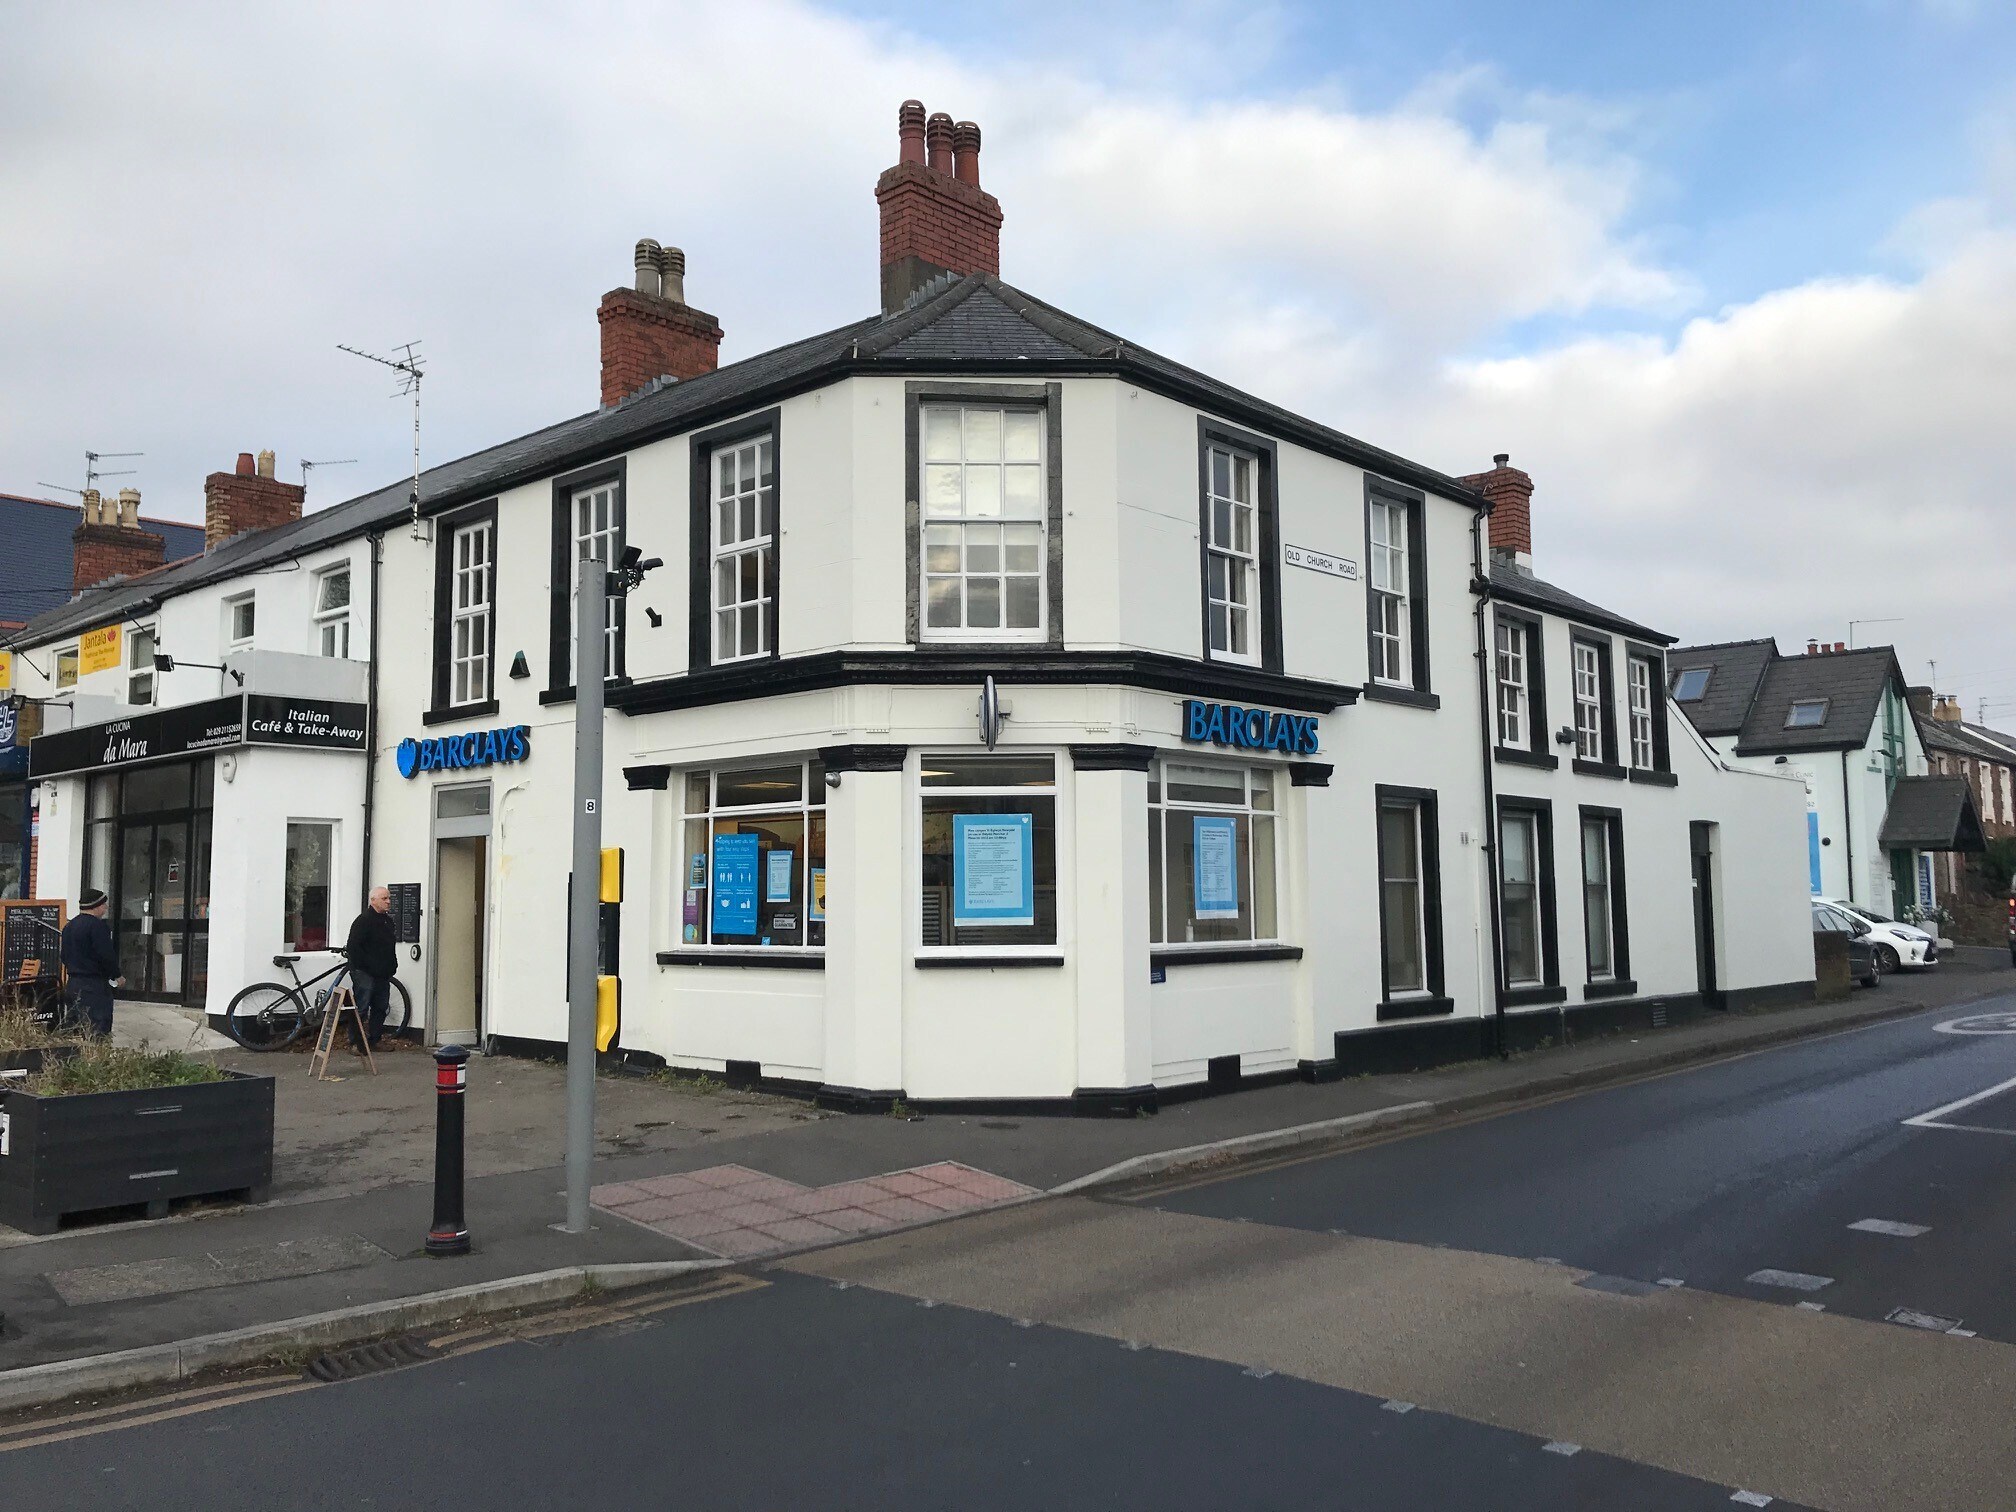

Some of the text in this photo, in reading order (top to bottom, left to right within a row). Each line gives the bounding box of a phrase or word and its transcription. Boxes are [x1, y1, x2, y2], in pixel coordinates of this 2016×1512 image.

[1287, 550, 1355, 575] OLD CHURCH ROAD
[288, 709, 330, 723] Italian
[1183, 700, 1319, 755] BARCLAYS
[105, 721, 131, 735] LA CUCINA
[251, 719, 364, 741] Café & Take-Away
[103, 735, 148, 763] da Mara
[420, 725, 530, 771] BARCLAYS
[587, 801, 594, 811] 8
